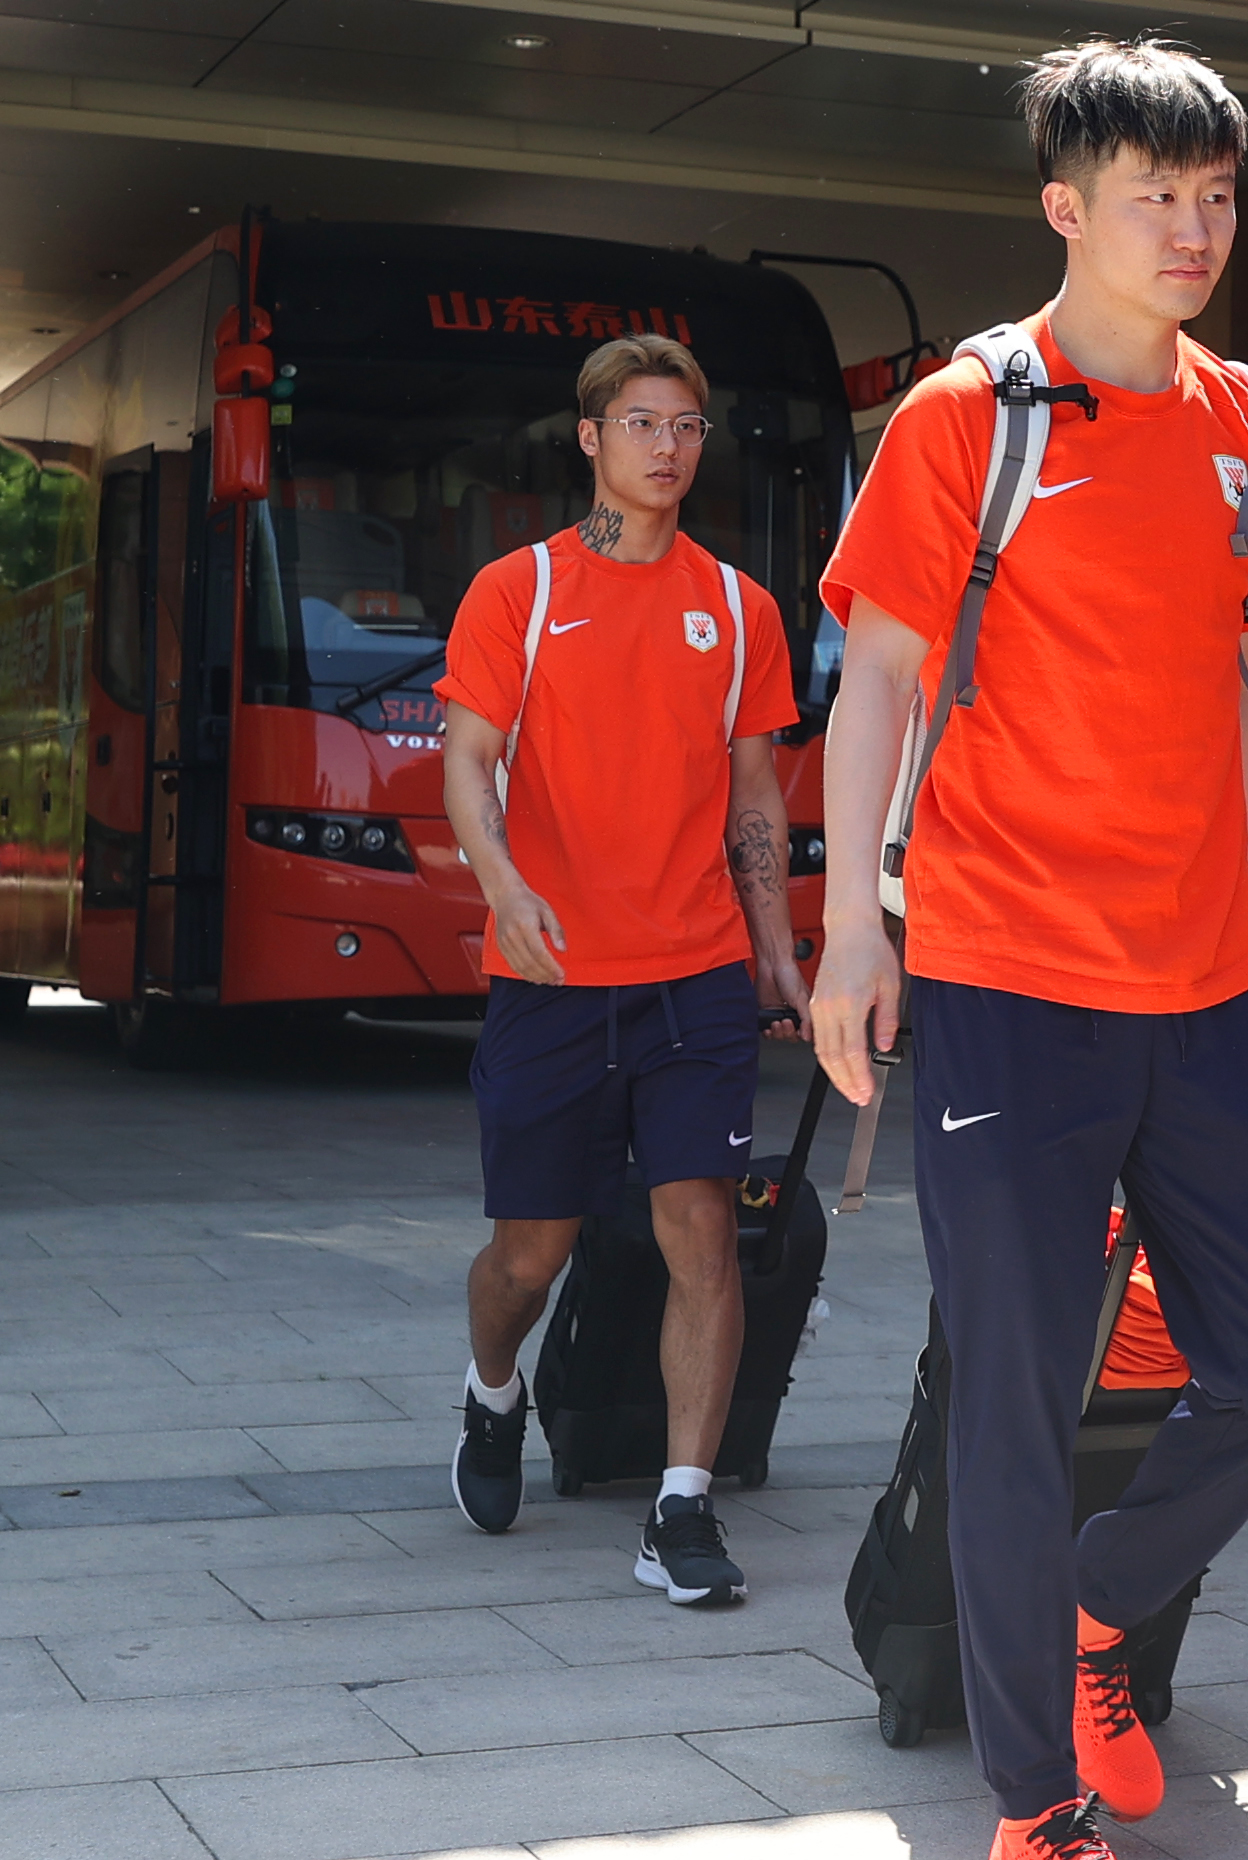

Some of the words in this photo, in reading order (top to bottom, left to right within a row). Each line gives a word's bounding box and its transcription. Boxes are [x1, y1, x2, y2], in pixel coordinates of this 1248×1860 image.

[427, 291, 692, 346] 山东泰山
[386, 734, 446, 750] VOL
